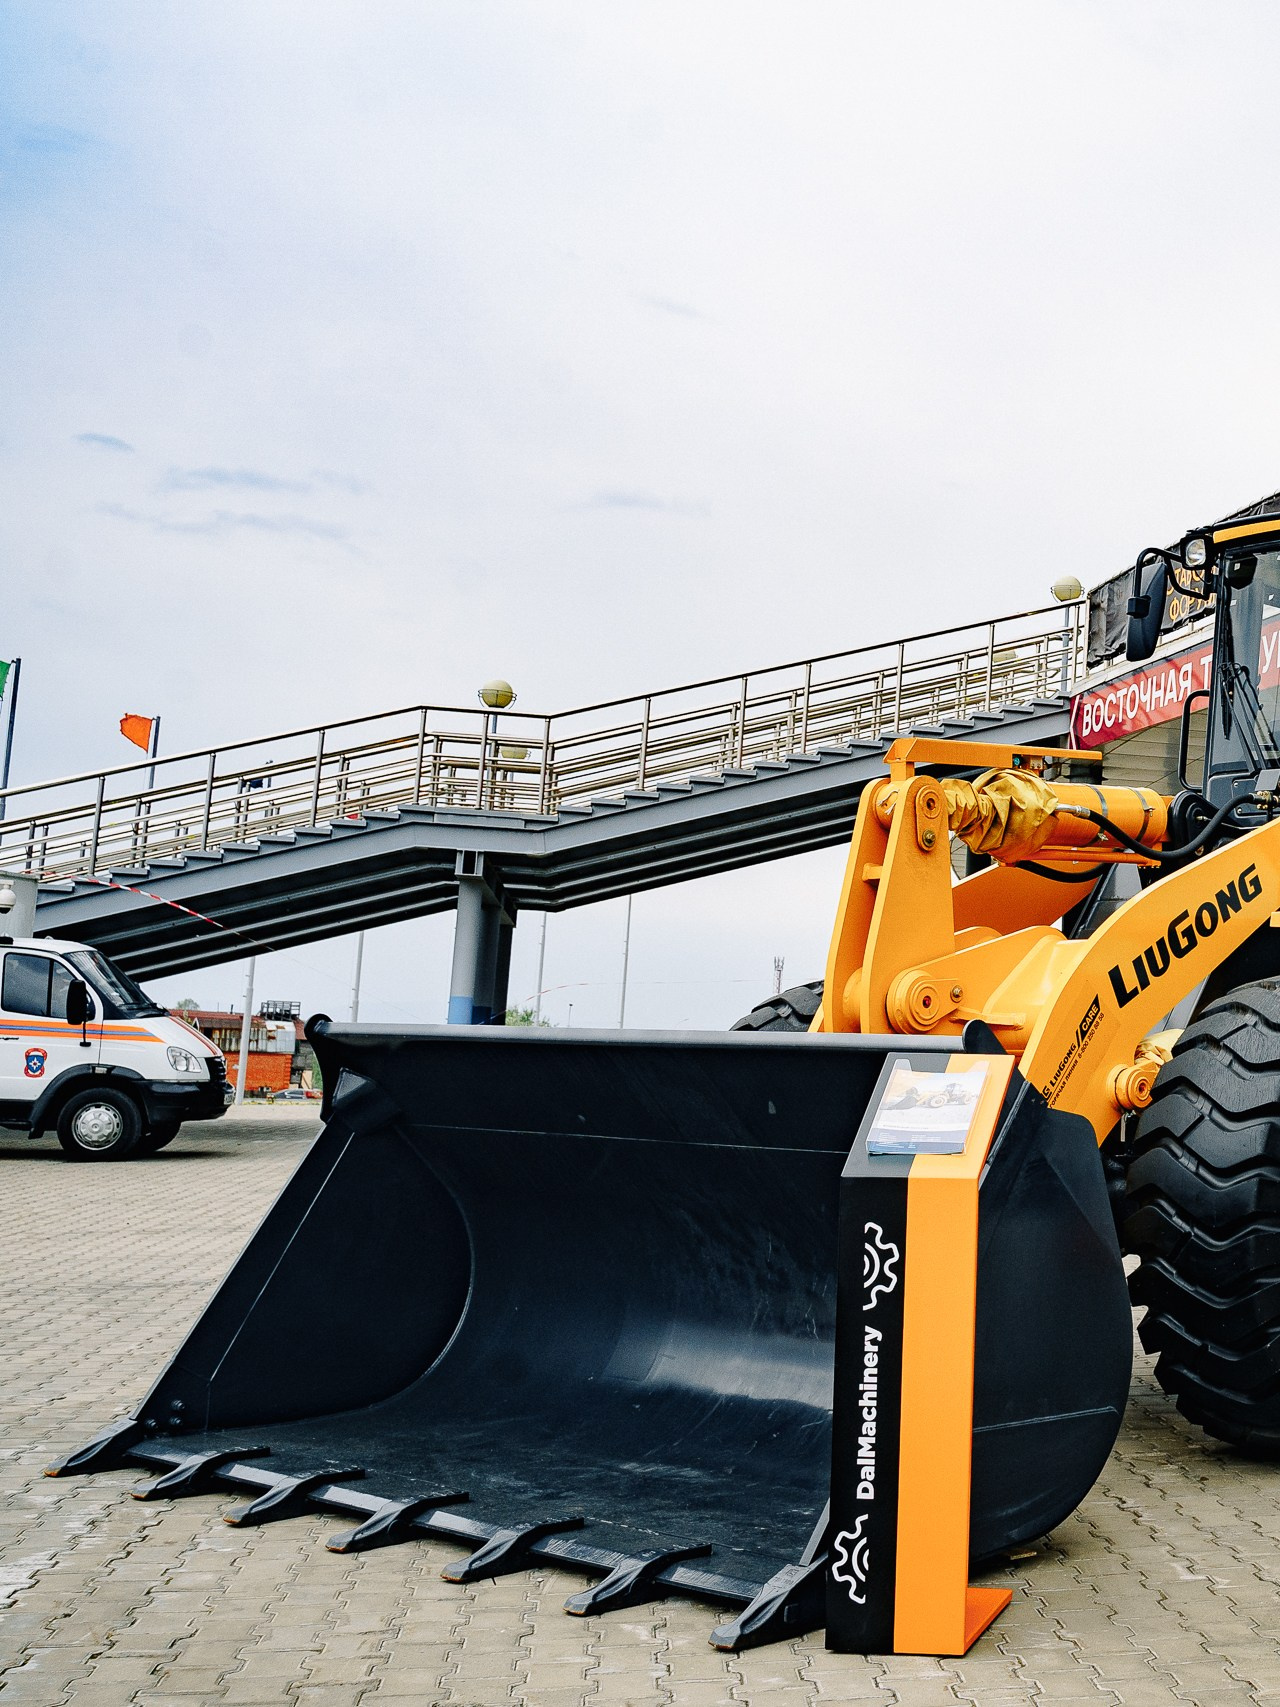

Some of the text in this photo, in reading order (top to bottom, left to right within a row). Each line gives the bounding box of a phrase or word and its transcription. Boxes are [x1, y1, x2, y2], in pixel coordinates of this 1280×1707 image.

[1082, 662, 1193, 737] ВОСТОЧНАЯ
[1082, 1004, 1099, 1031] CARE
[856, 1325, 883, 1500] DalMachinery
